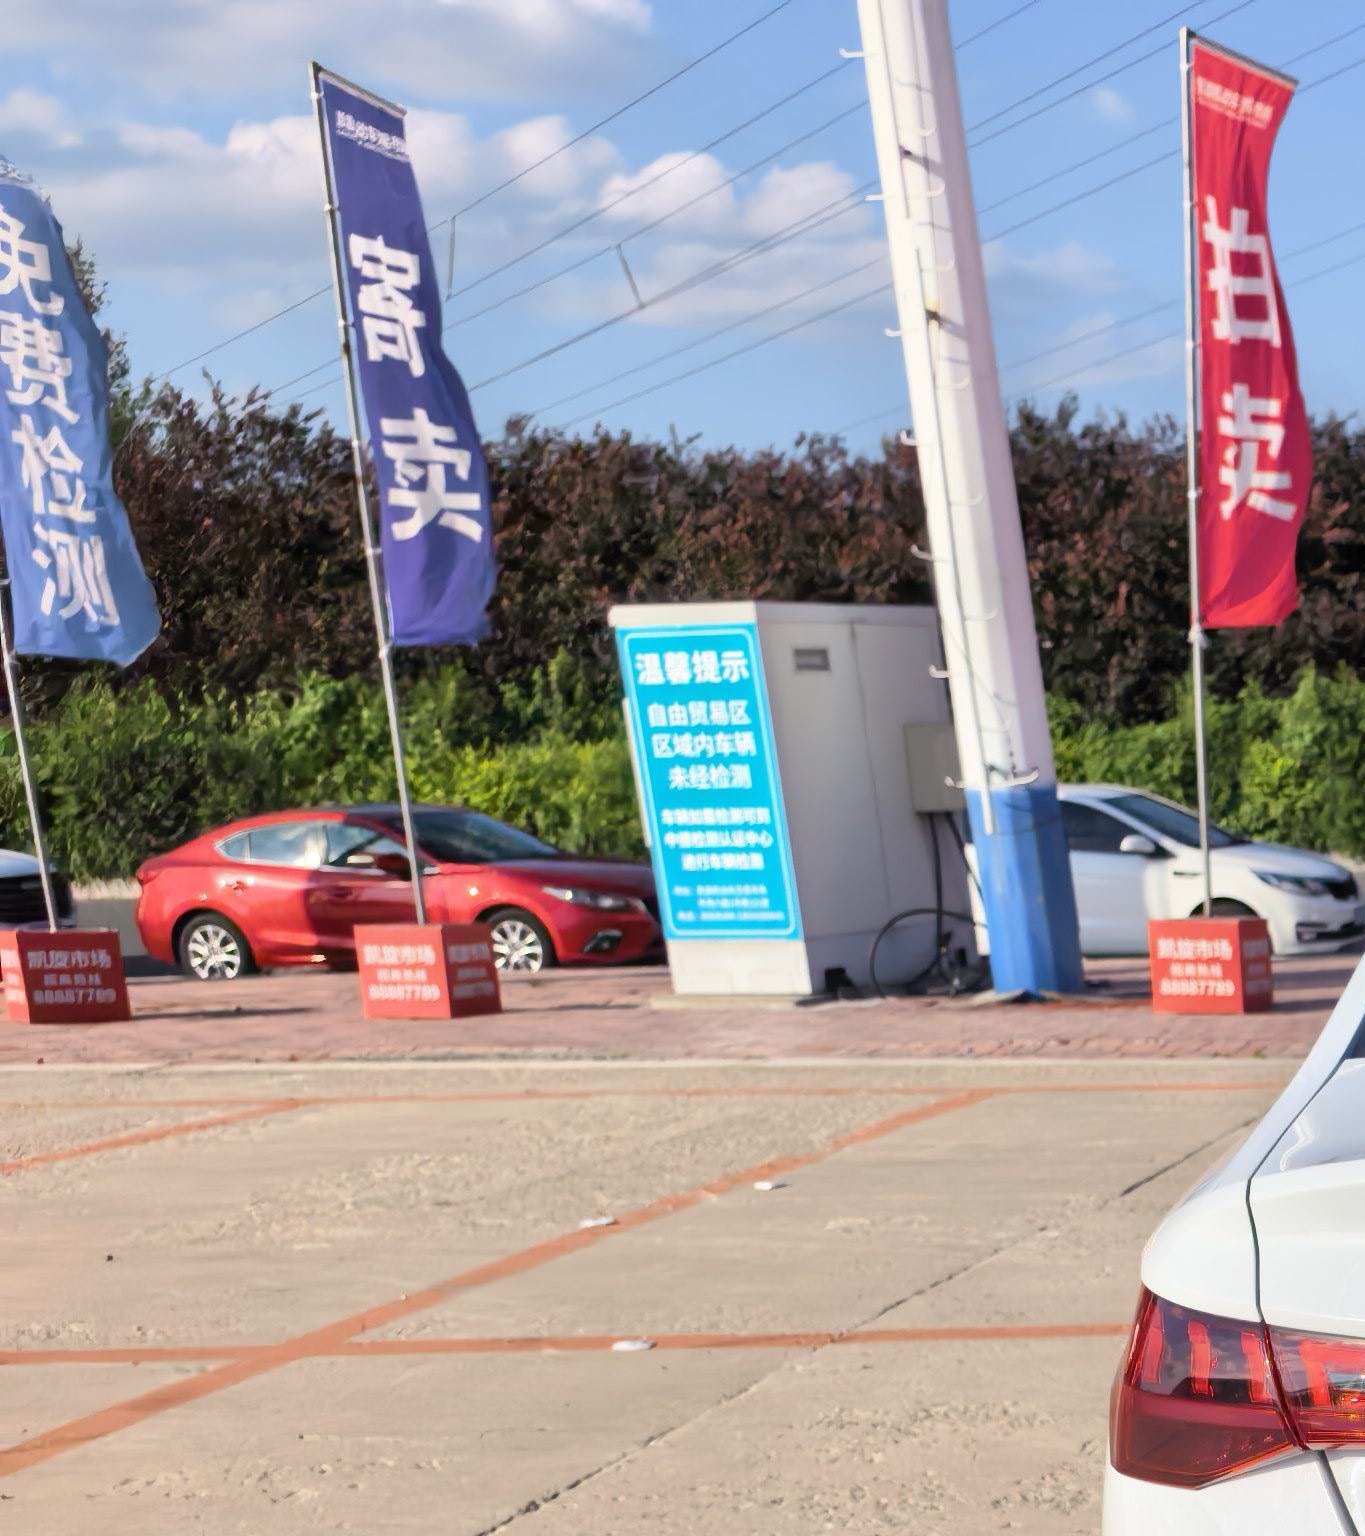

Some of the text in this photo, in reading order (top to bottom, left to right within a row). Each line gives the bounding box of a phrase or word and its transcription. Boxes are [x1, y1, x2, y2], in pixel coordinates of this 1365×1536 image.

[1203, 195, 1297, 521] 拍卖
[349, 232, 483, 544] 寄卖
[634, 650, 749, 685] 温馨提示
[647, 700, 752, 728] 自由贸易区
[652, 731, 757, 758] 区域内车辆
[669, 763, 752, 789] 未经检测
[27, 949, 111, 969] 凯旋市场
